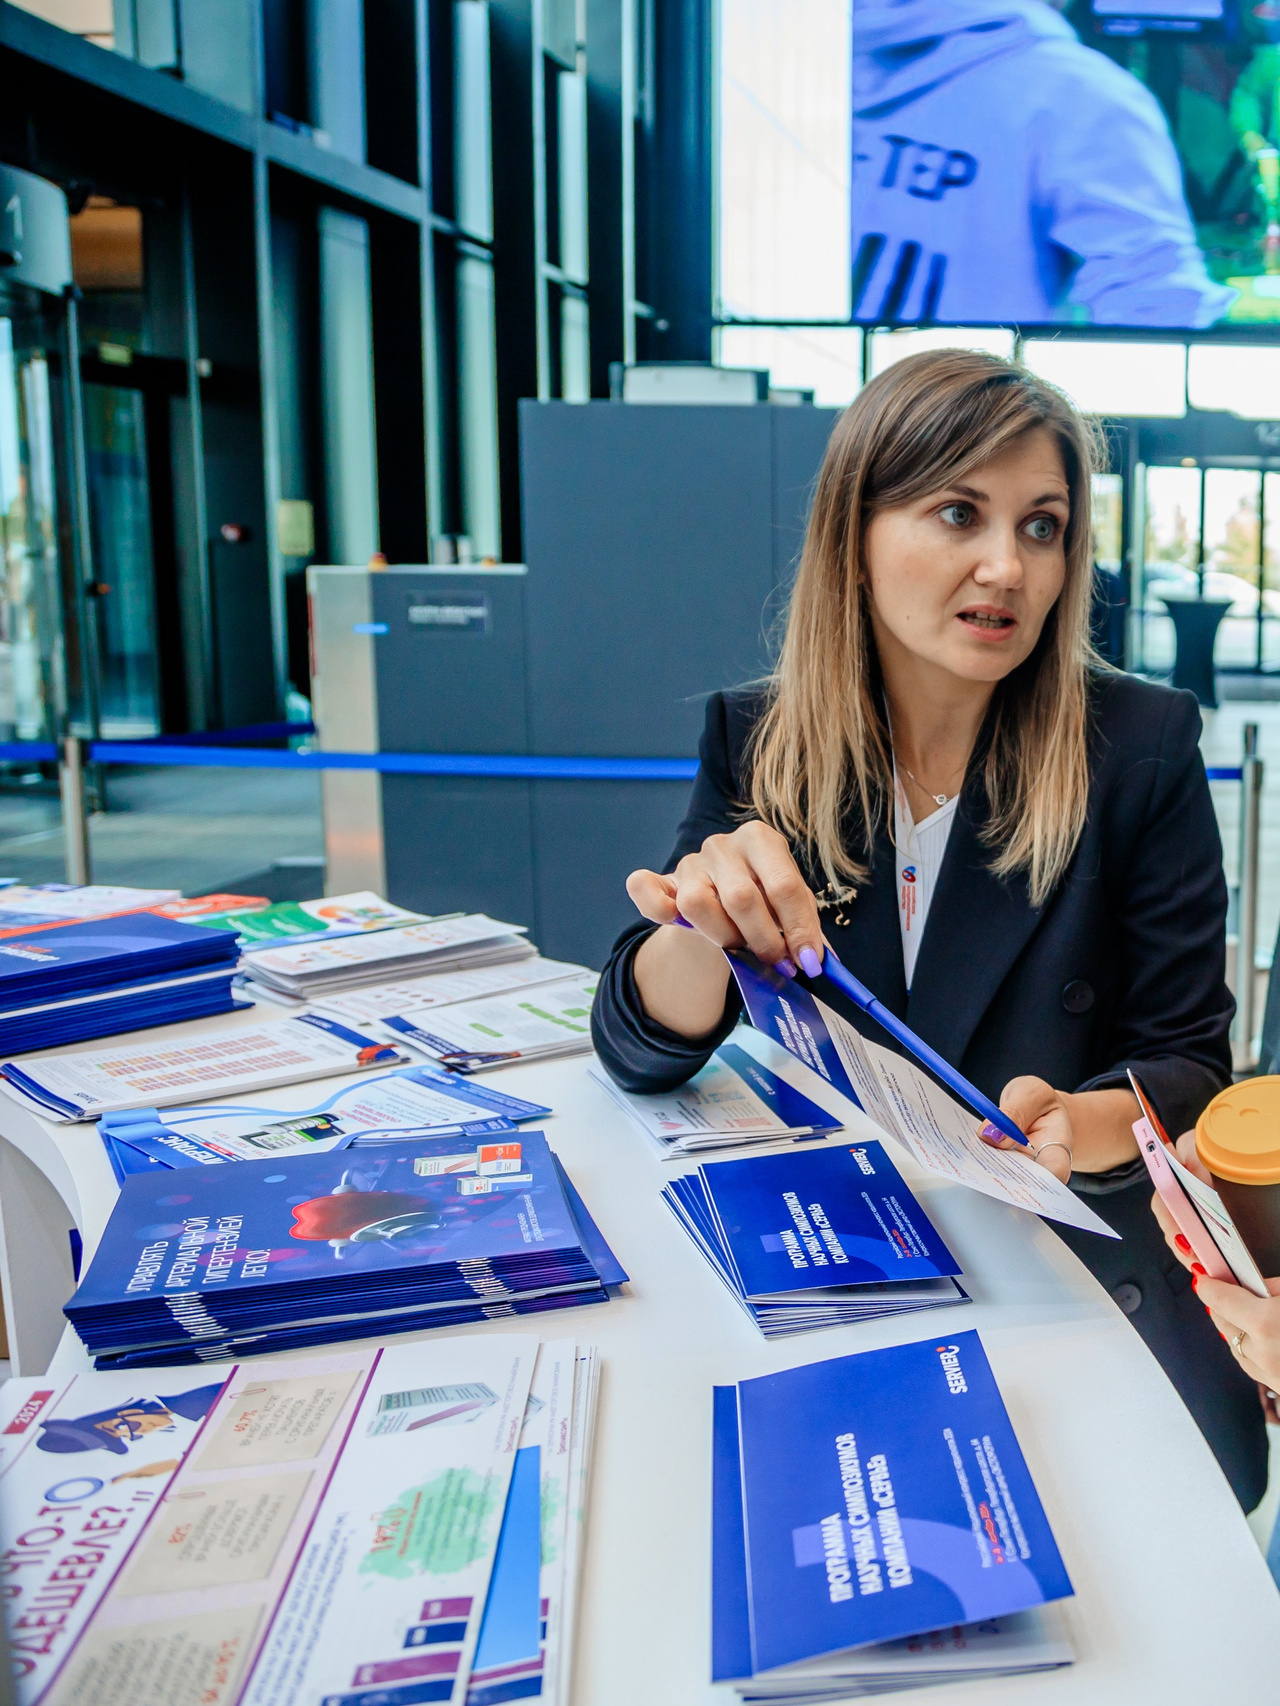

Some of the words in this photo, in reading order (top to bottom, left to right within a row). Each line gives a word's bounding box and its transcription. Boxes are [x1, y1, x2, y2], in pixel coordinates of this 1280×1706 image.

[850, 1148, 876, 1175] SERVIER
[782, 1191, 814, 1236] СИМПОЗИУМОВ
[124, 1240, 169, 1294] УПРАВЛЯТЬ
[164, 1216, 210, 1287] АРТЕРИАЛЬНОЙ
[202, 1214, 244, 1284] ГИПЕРТЕНЗИЕЙ
[240, 1249, 271, 1278] ЛЕГКО!
[780, 1229, 809, 1269] ПРОГРАММА
[802, 1235, 829, 1266] НАУЧНЫХ
[819, 1228, 849, 1264] КОМПАНИИ
[937, 1345, 968, 1394] SERVIER
[835, 1432, 871, 1526] СИМПОЗИУМОВ
[866, 1454, 897, 1508] «СЕРВЬЕ»
[821, 1512, 854, 1603] ПРОГРАММА
[850, 1524, 884, 1596] НАУЧНЫХ
[876, 1506, 913, 1589] КОМПАНИИ
